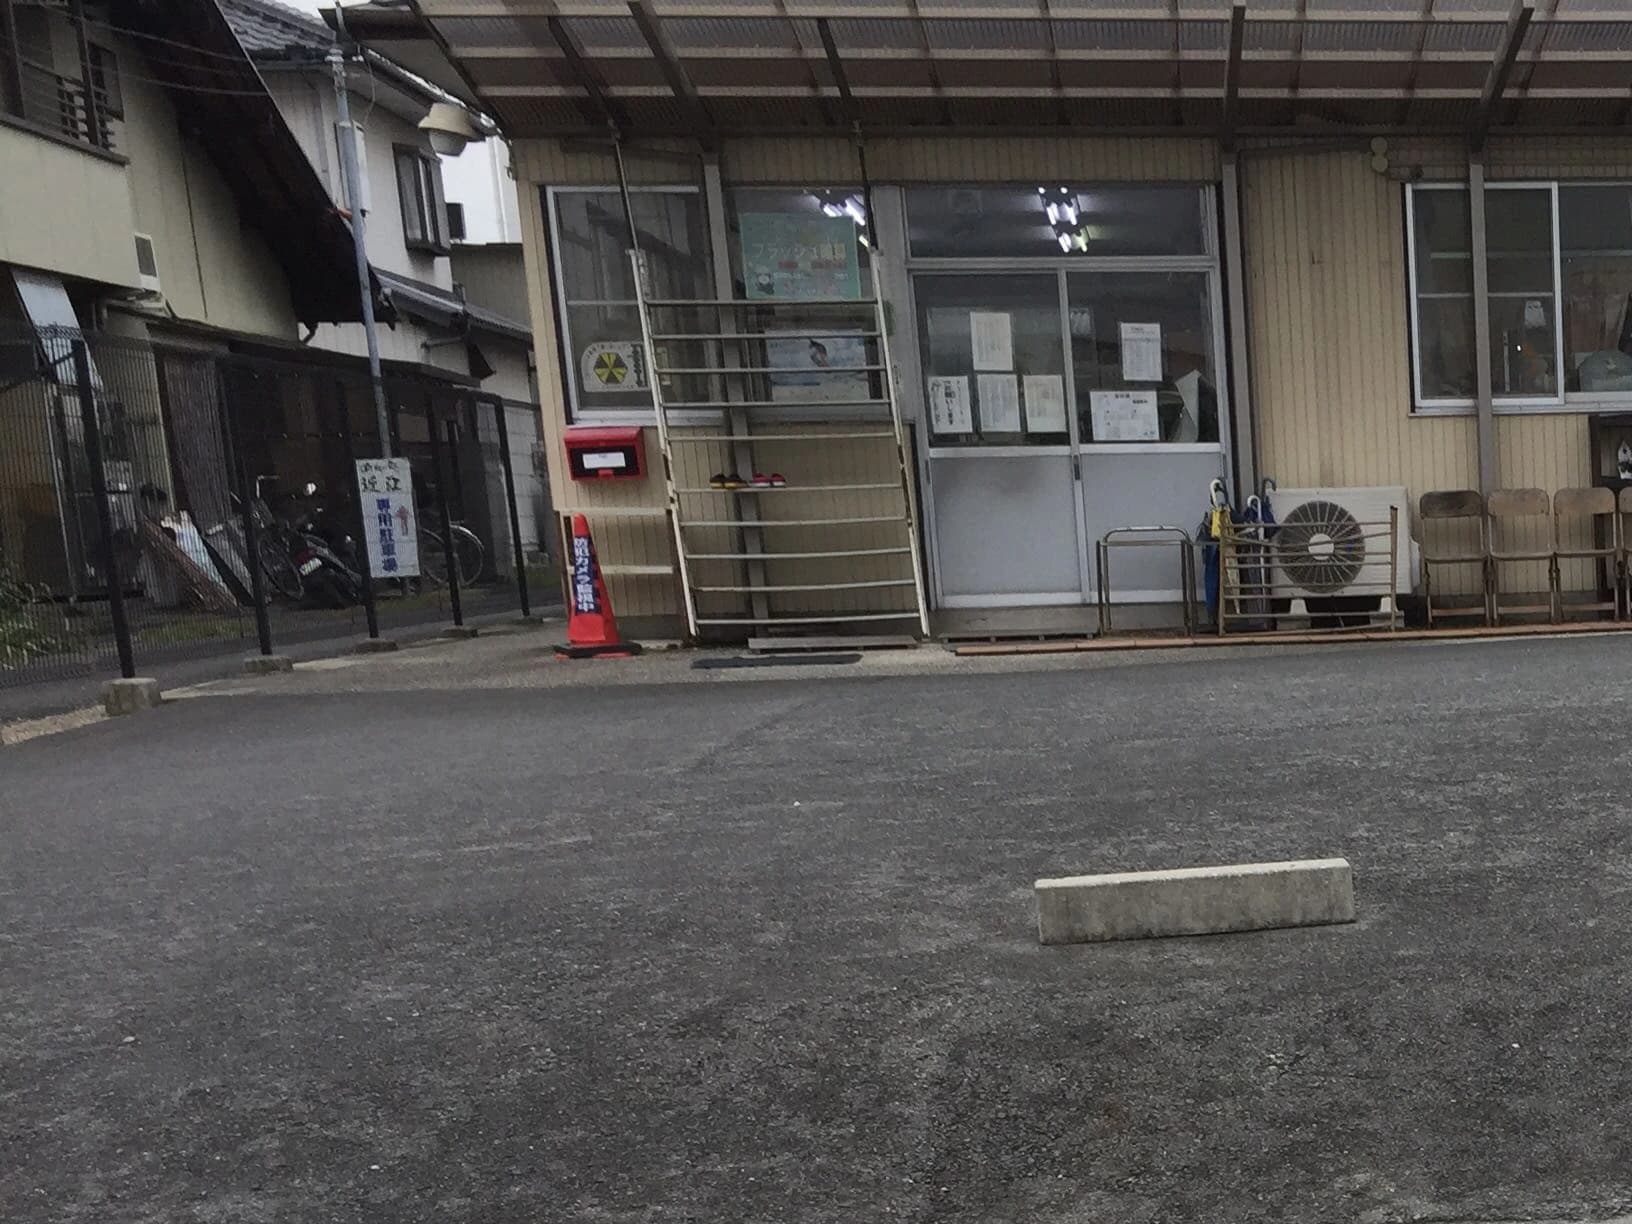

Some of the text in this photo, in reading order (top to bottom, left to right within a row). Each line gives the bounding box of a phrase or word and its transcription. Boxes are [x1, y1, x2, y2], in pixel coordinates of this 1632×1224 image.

[376, 499, 398, 573] 専用駐車場
[574, 537, 595, 612] 防犯カメラ監視中
